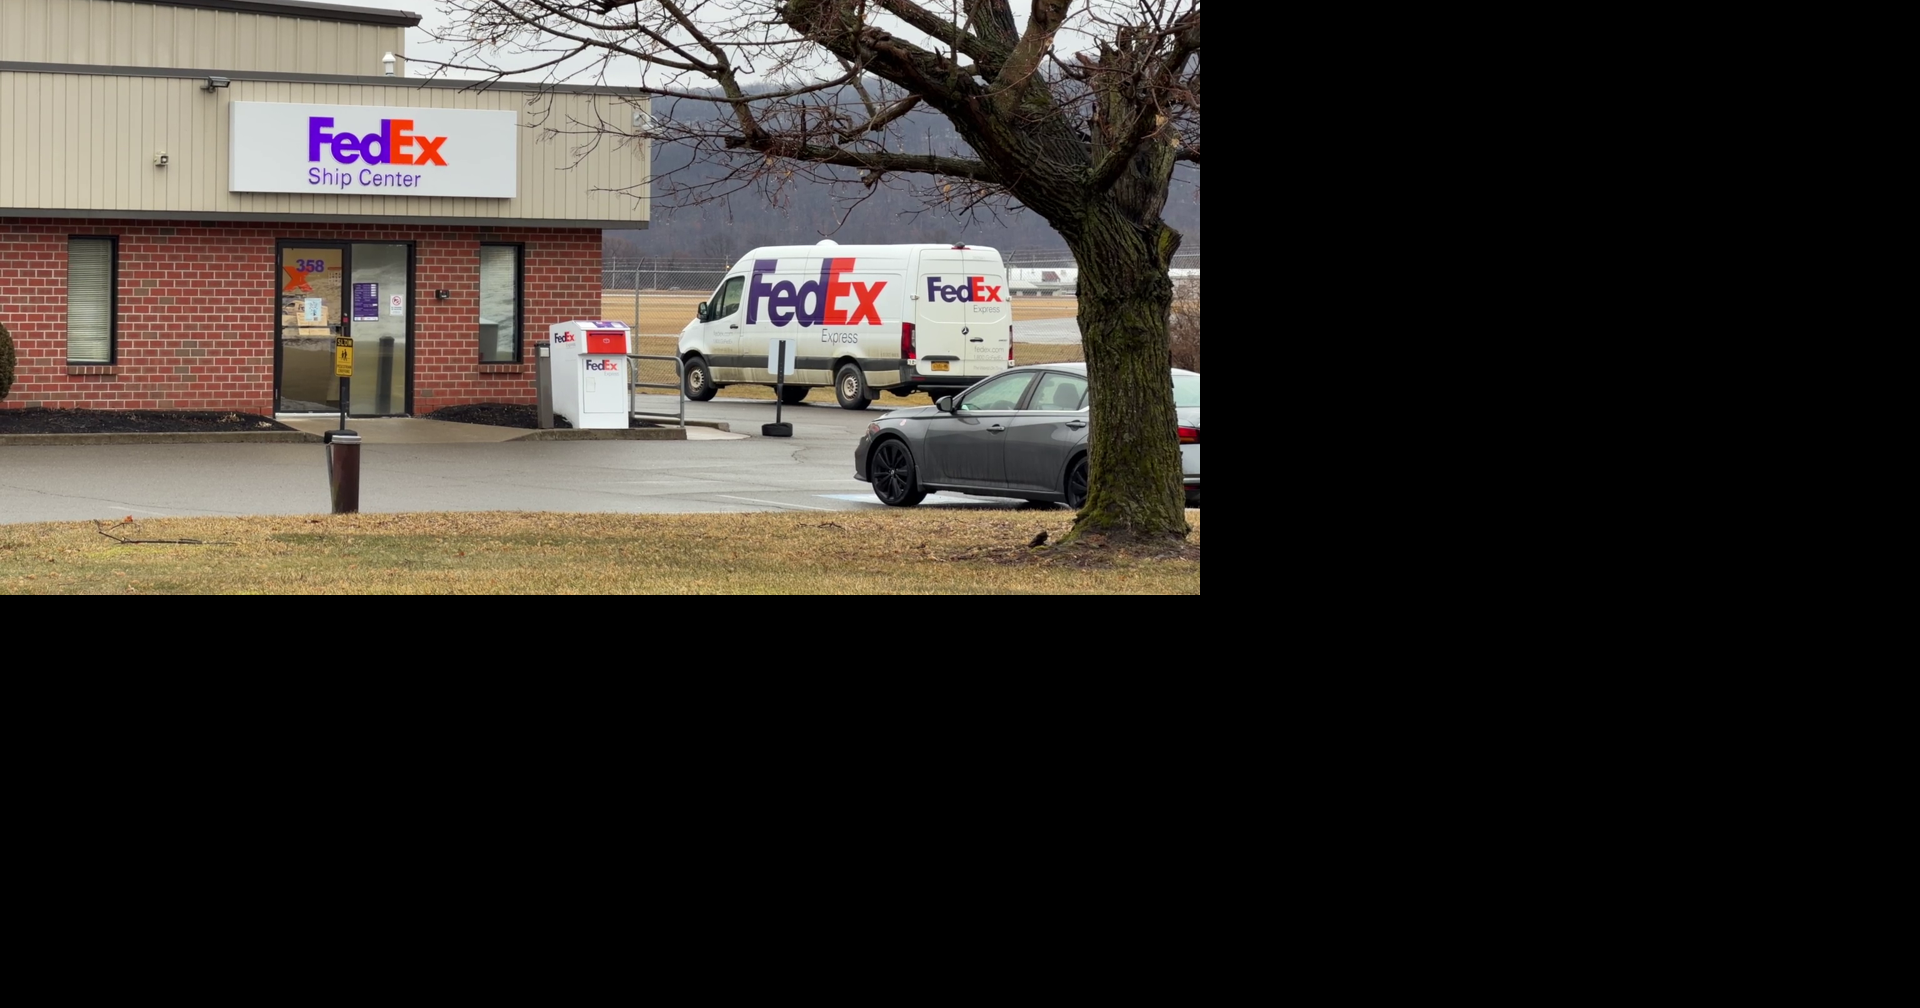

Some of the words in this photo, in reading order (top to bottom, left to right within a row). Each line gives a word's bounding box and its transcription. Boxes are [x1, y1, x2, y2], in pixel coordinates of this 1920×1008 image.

[308, 116, 448, 166] FedEx
[308, 167, 352, 190] Ship
[359, 168, 421, 187] Center
[296, 259, 324, 273] 358
[746, 257, 888, 327] FedEx
[927, 276, 1002, 303] FedEx
[973, 305, 1000, 314] Express
[554, 331, 575, 343] FedEx
[821, 329, 858, 345] Express
[586, 359, 618, 371] FedEx
